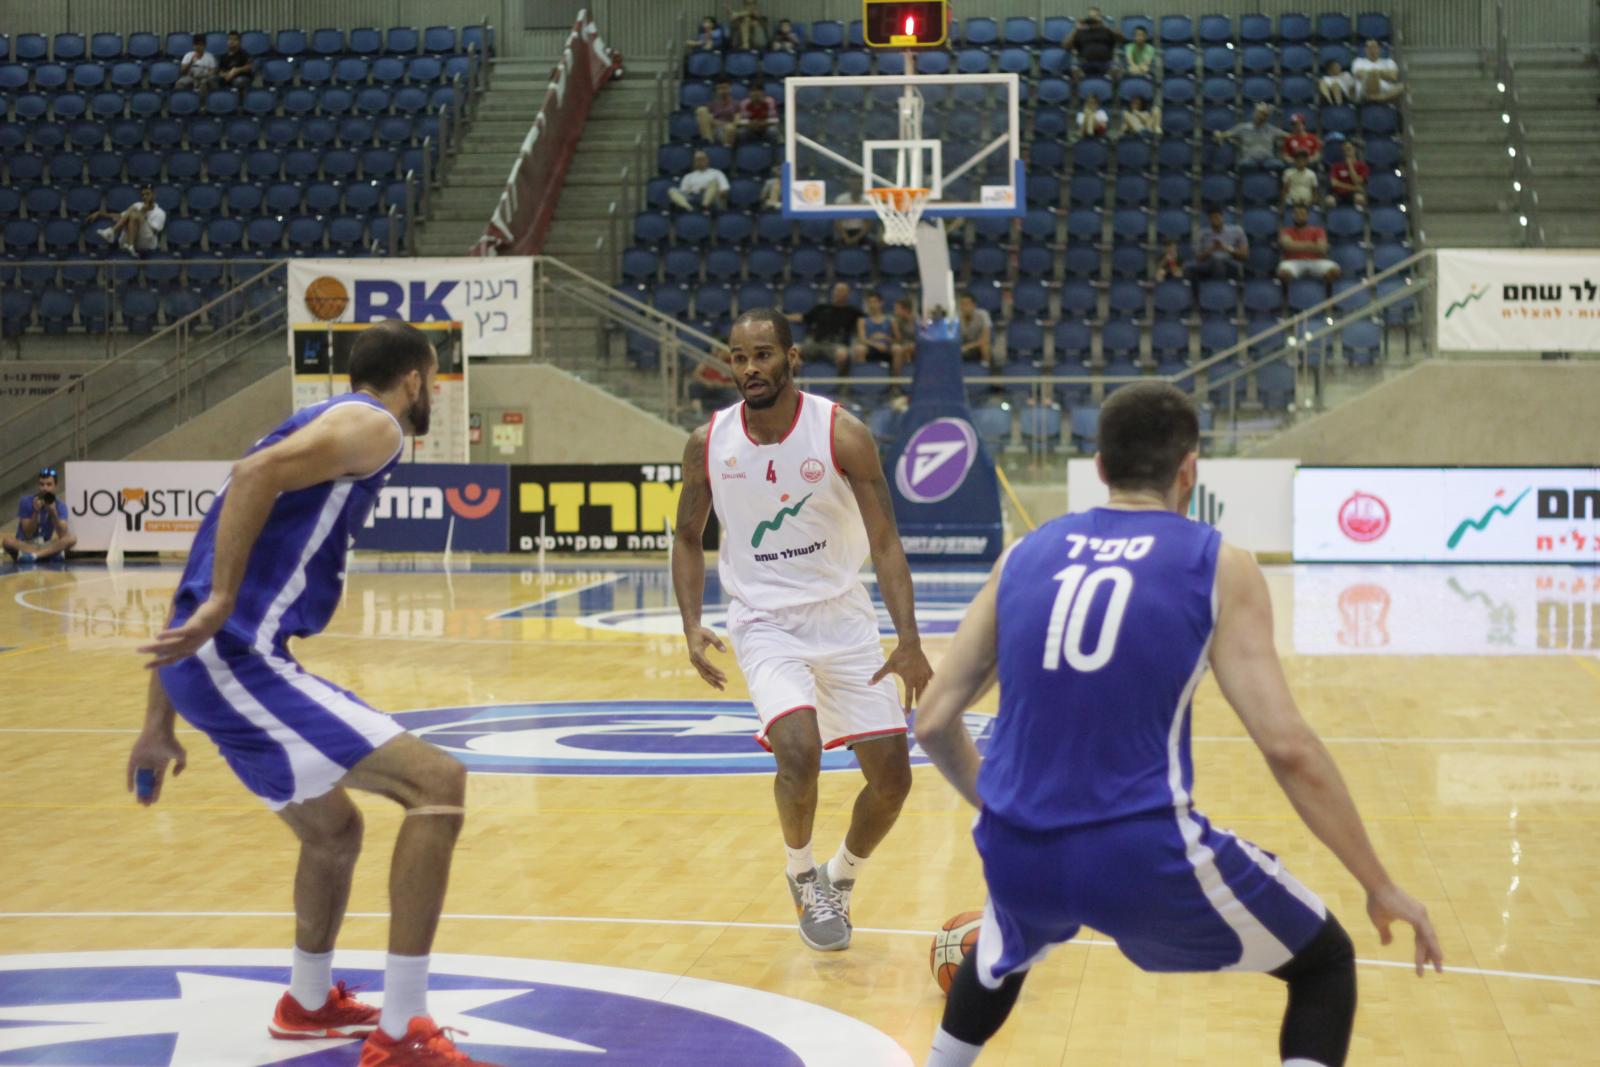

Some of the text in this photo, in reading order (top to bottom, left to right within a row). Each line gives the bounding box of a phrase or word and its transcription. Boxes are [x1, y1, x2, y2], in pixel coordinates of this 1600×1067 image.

[354, 279, 462, 324] BK
[465, 279, 519, 306] רענן
[1503, 285, 1562, 301] שחם
[474, 310, 509, 339] כץ
[766, 459, 777, 484] 4
[627, 535, 675, 550] טחה
[1065, 533, 1155, 561] ספיר
[1042, 563, 1134, 673] 10
